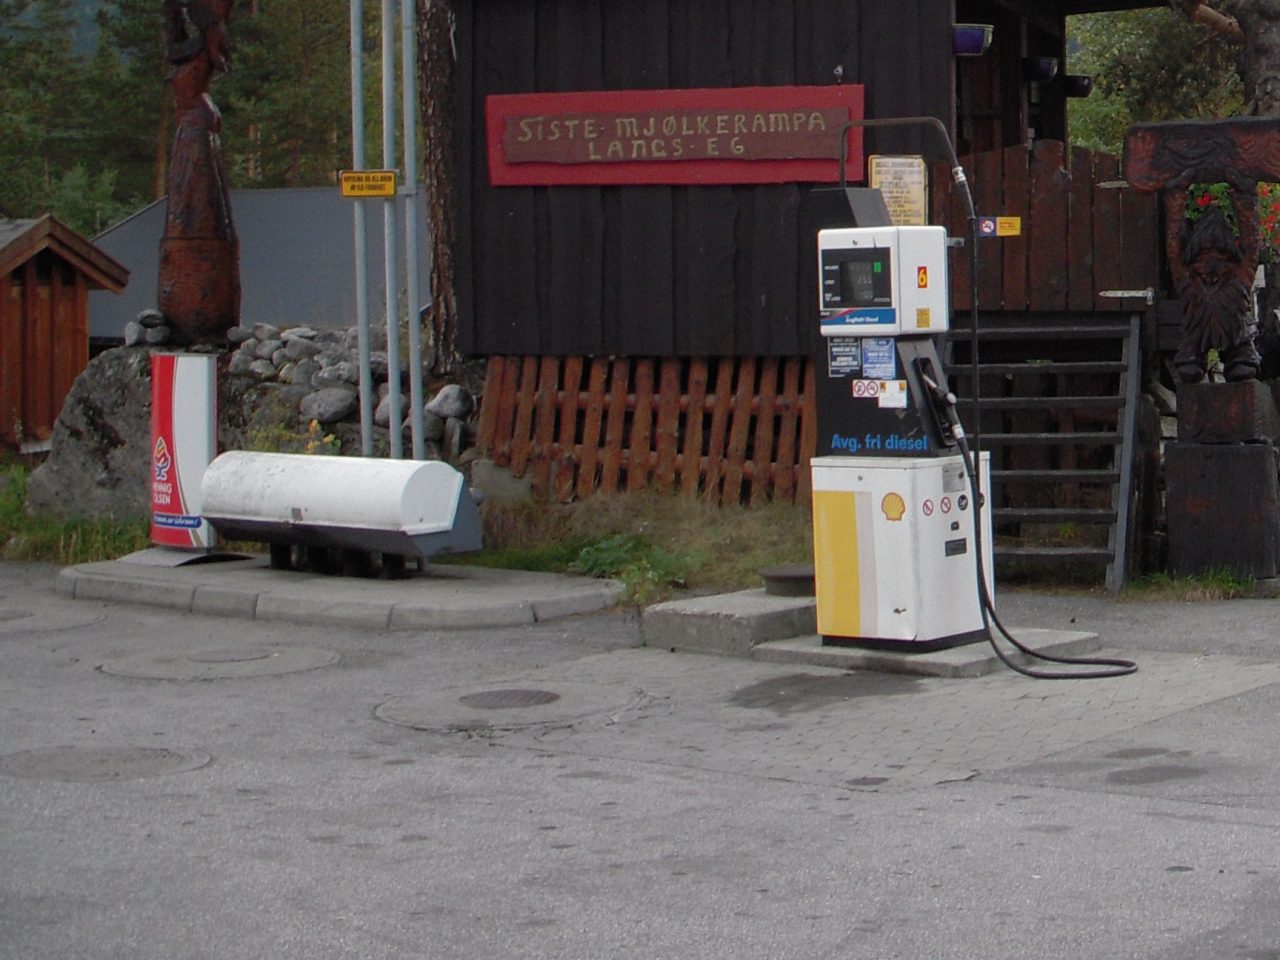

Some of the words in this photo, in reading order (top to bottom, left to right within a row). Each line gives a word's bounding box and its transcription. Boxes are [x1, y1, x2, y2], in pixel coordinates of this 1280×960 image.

[615, 111, 826, 138] MJØLKERAMPA
[918, 268, 927, 287] 6
[831, 433, 862, 453] Avg.
[865, 433, 881, 449] fri
[885, 433, 929, 450] diesel
